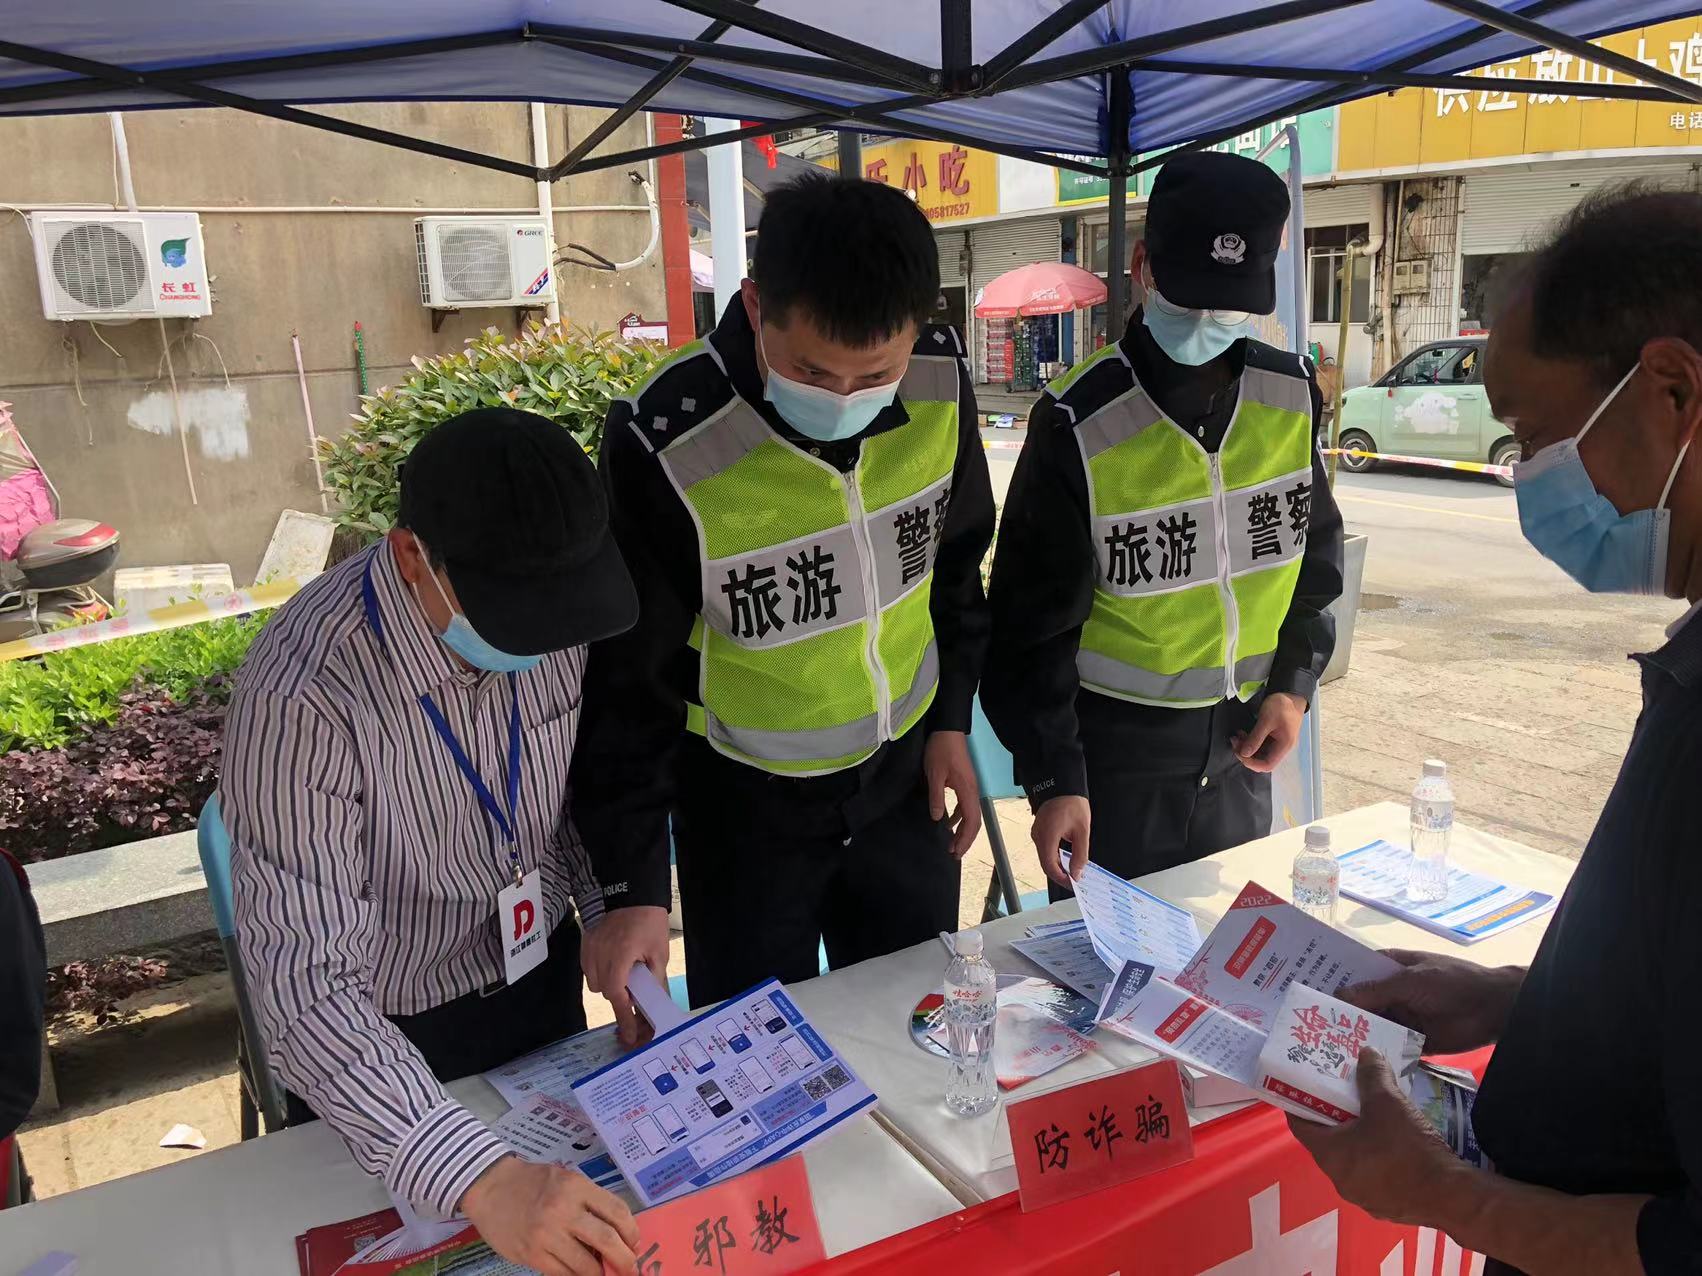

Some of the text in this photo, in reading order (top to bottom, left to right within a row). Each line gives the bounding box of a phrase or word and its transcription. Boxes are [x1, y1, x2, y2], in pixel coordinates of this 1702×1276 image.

[1670, 111, 1702, 130] 电话
[161, 282, 197, 293] 长虹
[1104, 482, 1313, 588] 旅游 警察
[721, 545, 842, 640] 旅游
[1032, 777, 1056, 796] POLICE
[603, 881, 629, 898] POLICE
[1240, 894, 1272, 907] 2022
[1034, 1094, 1170, 1174] 防诈骗
